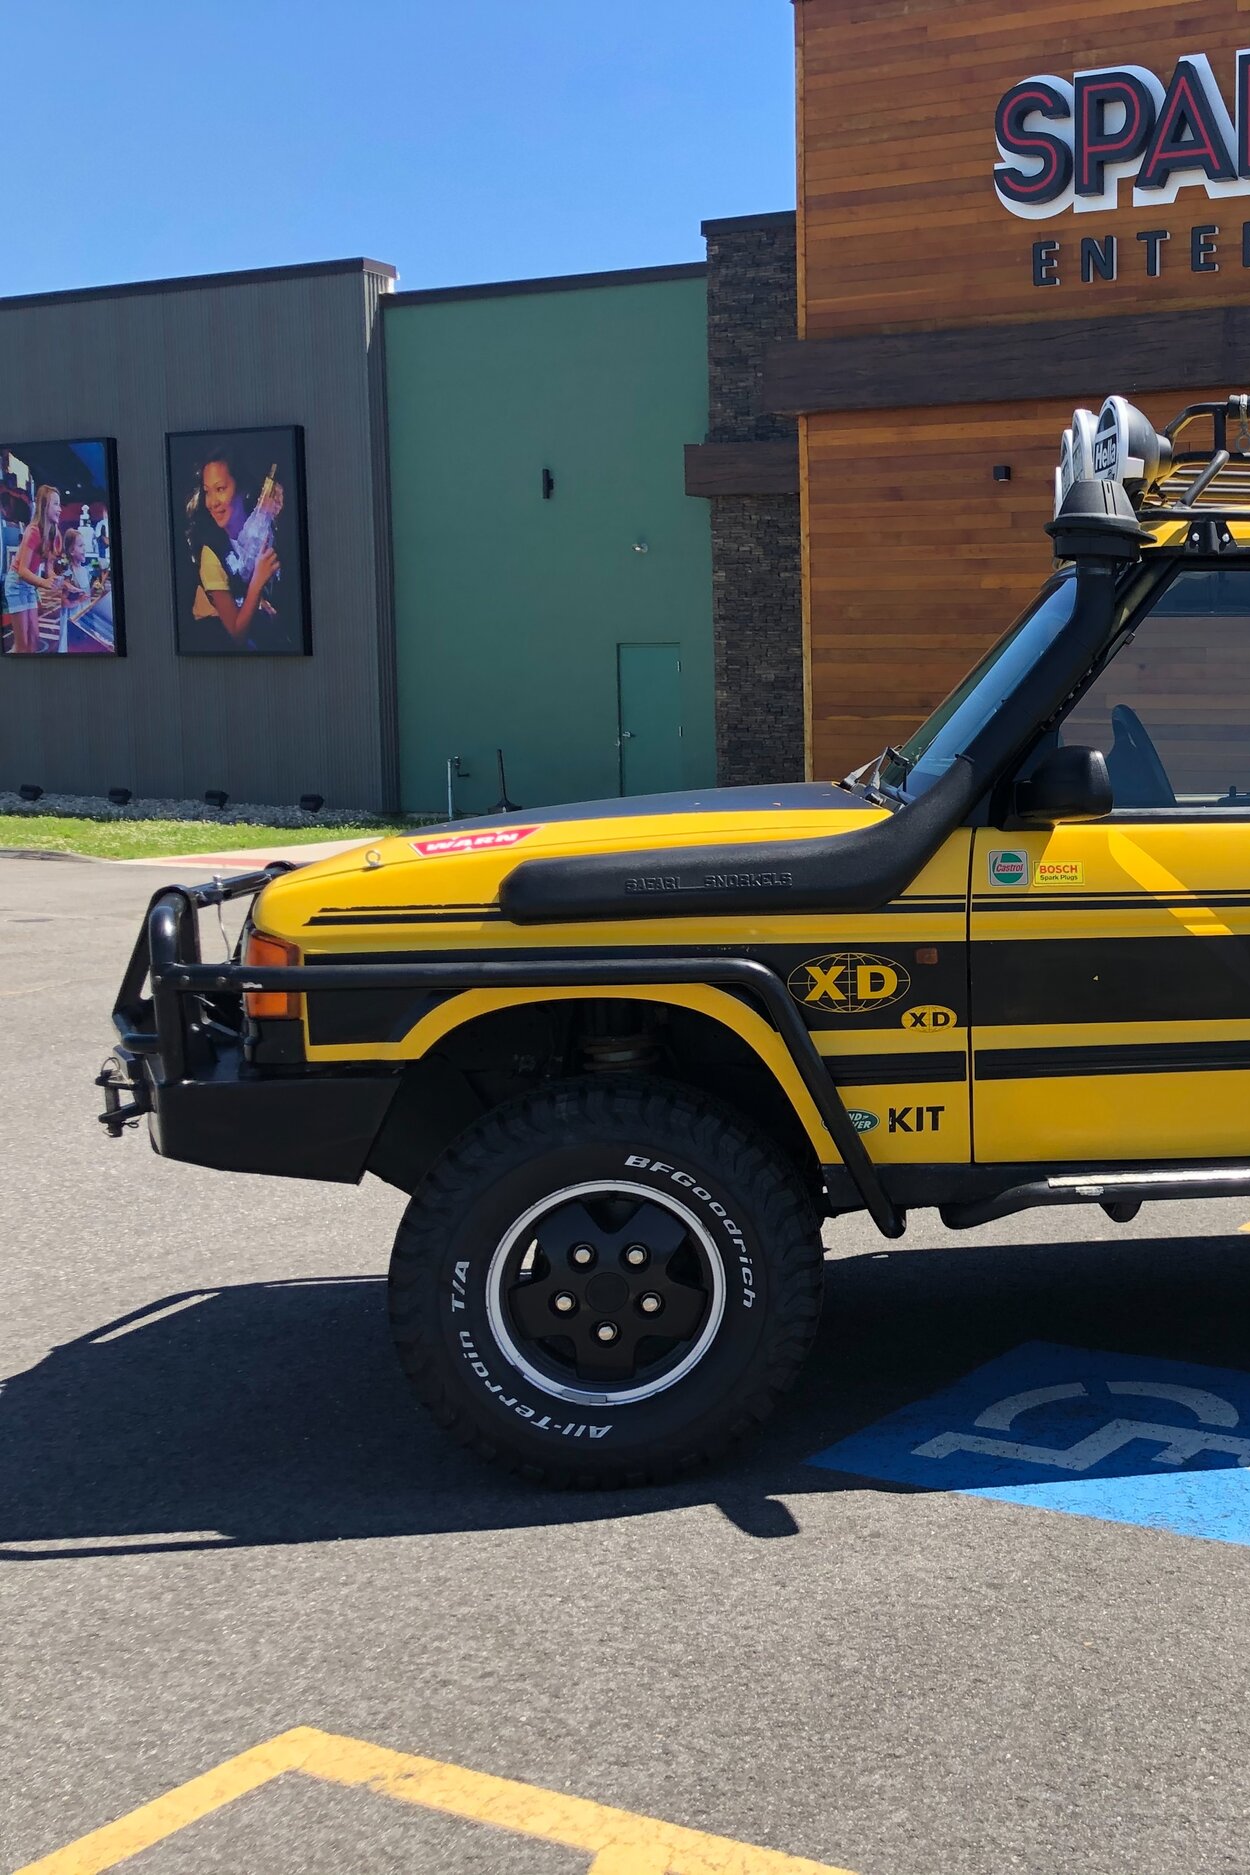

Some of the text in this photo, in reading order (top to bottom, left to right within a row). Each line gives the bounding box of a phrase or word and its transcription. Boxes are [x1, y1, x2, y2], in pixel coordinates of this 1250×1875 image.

[1094, 438, 1117, 471] Hella
[426, 831, 519, 851] WARN
[996, 863, 1024, 873] Castrol
[1040, 864, 1078, 874] BOSCH
[1060, 873, 1078, 881] Plugs
[624, 876, 681, 894] SAFARI
[804, 964, 898, 1001] XD
[909, 1011, 951, 1028] XD
[888, 1105, 945, 1133] KIT
[624, 1154, 756, 1309] BFGoodrich
[452, 1260, 614, 1439] All-Terrain T/A
